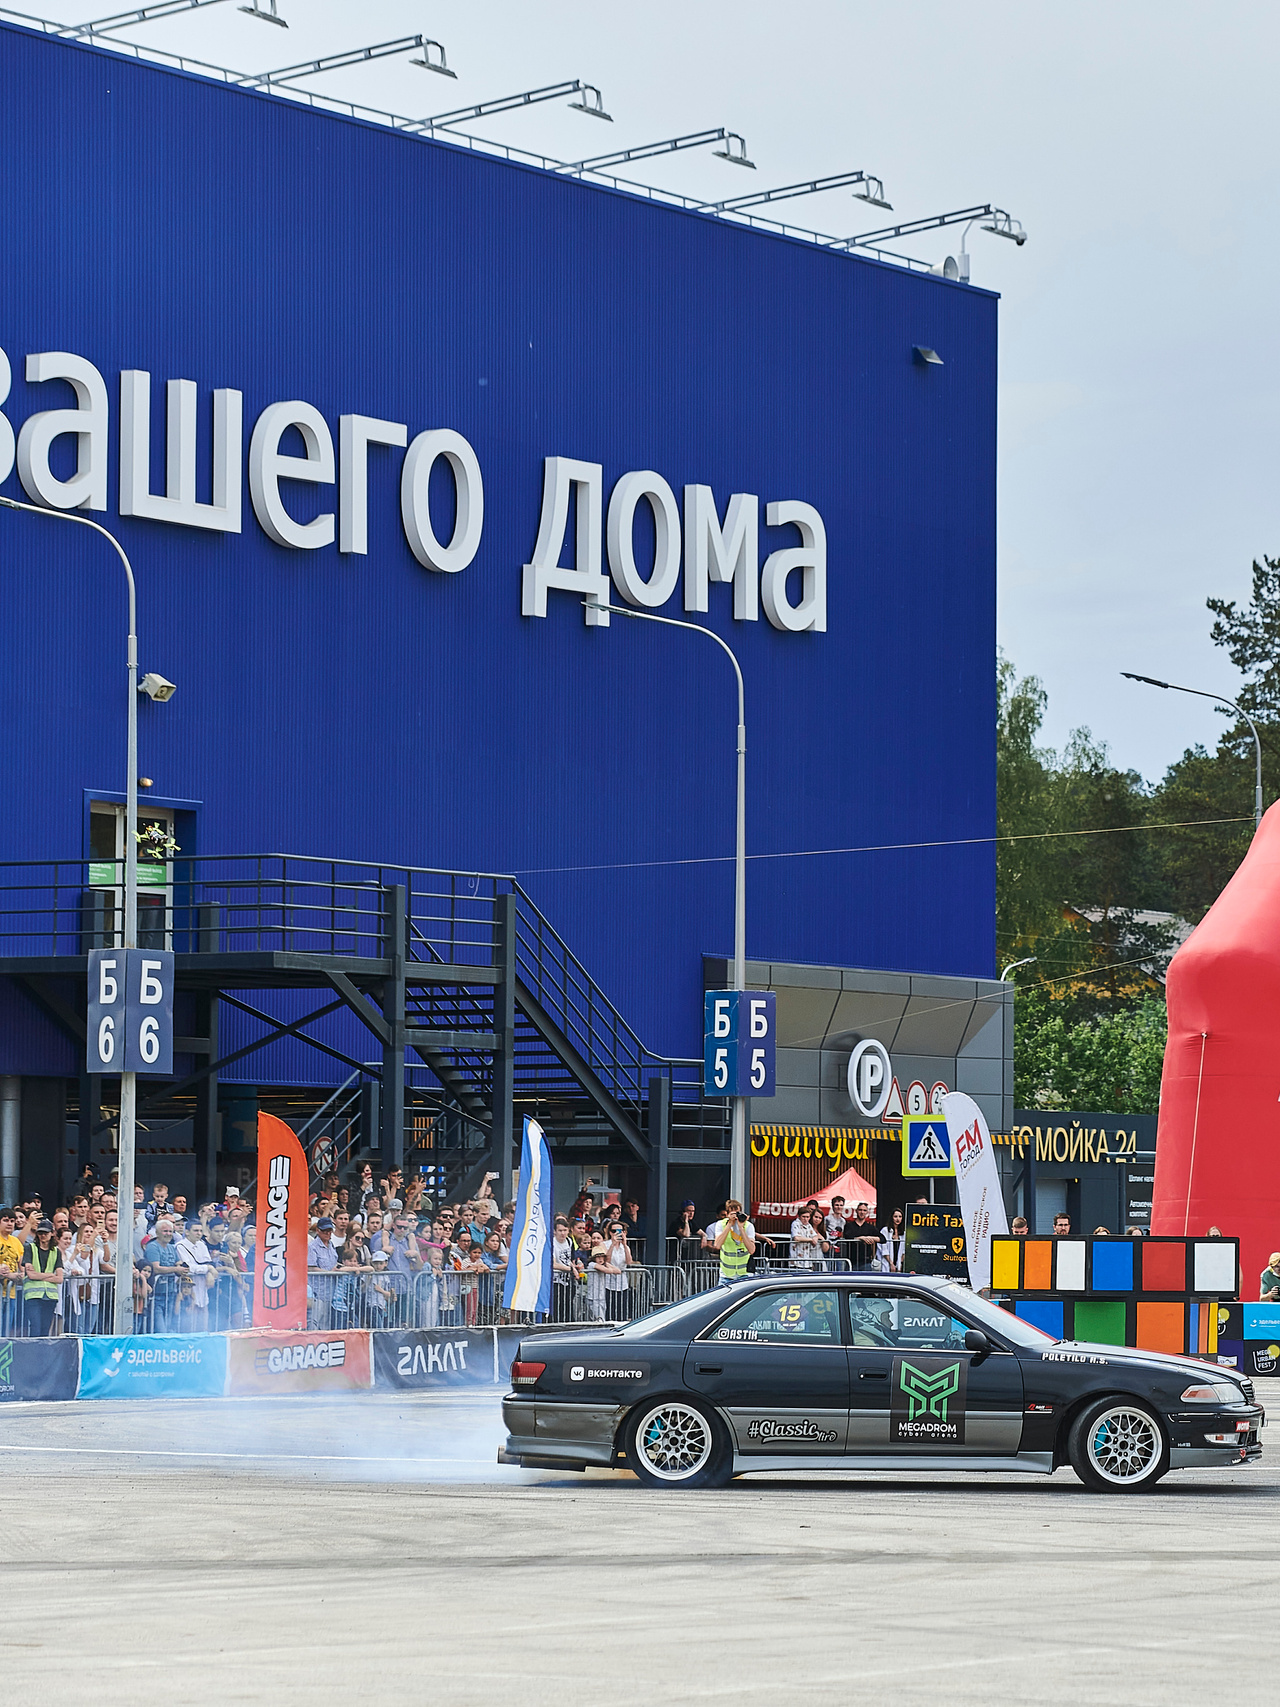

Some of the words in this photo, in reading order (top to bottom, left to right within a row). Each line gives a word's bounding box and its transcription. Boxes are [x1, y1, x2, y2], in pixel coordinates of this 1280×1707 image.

[0, 345, 484, 573] ашего
[522, 456, 827, 632] дома
[99, 960, 118, 1004] Б
[140, 960, 163, 1004] Б
[714, 1000, 731, 1038] Б
[750, 1000, 768, 1038] Б
[98, 1016, 115, 1063] 6
[139, 1016, 160, 1064] 6
[714, 1048, 728, 1088] 5
[750, 1048, 766, 1088] 5
[914, 1095, 920, 1111] 5
[956, 1118, 983, 1162] FM
[1116, 1130, 1137, 1163] 24
[263, 1155, 291, 1289] GARAGE
[758, 1202, 801, 1216] MOTU
[912, 1213, 939, 1227] Drift
[779, 1305, 801, 1321] 15
[127, 1345, 202, 1367] эдельвейс
[268, 1340, 346, 1373] GARAGE
[1257, 1355, 1276, 1363] URBAN
[899, 1422, 957, 1433] MEGADROM
